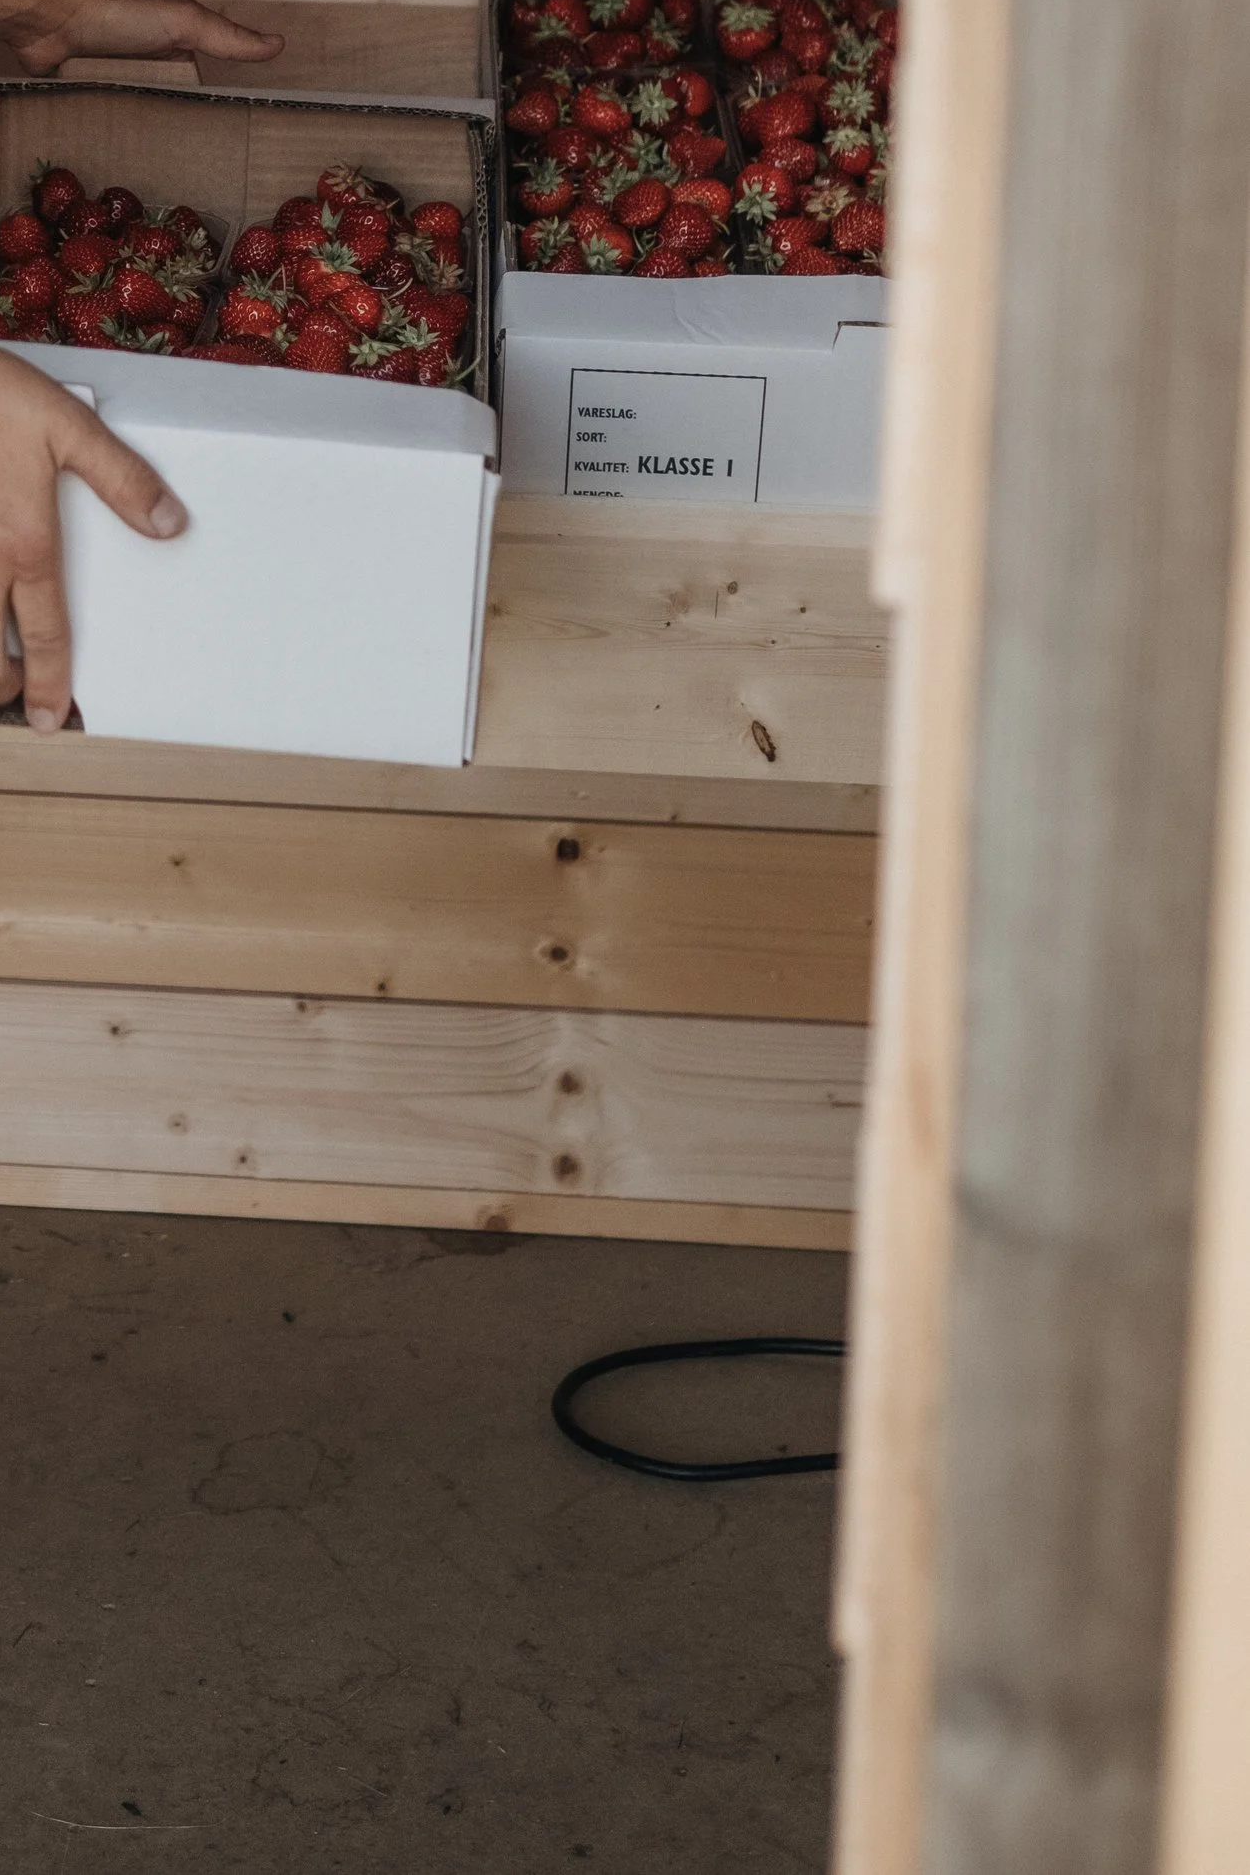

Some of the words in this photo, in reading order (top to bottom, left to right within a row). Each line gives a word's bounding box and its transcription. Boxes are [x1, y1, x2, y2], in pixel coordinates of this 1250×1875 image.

[577, 407, 637, 419] VARESLAG:
[576, 432, 607, 443] SORT:
[574, 461, 629, 473] KVALITET:
[638, 455, 714, 476] KLASSE
[727, 459, 733, 477] I
